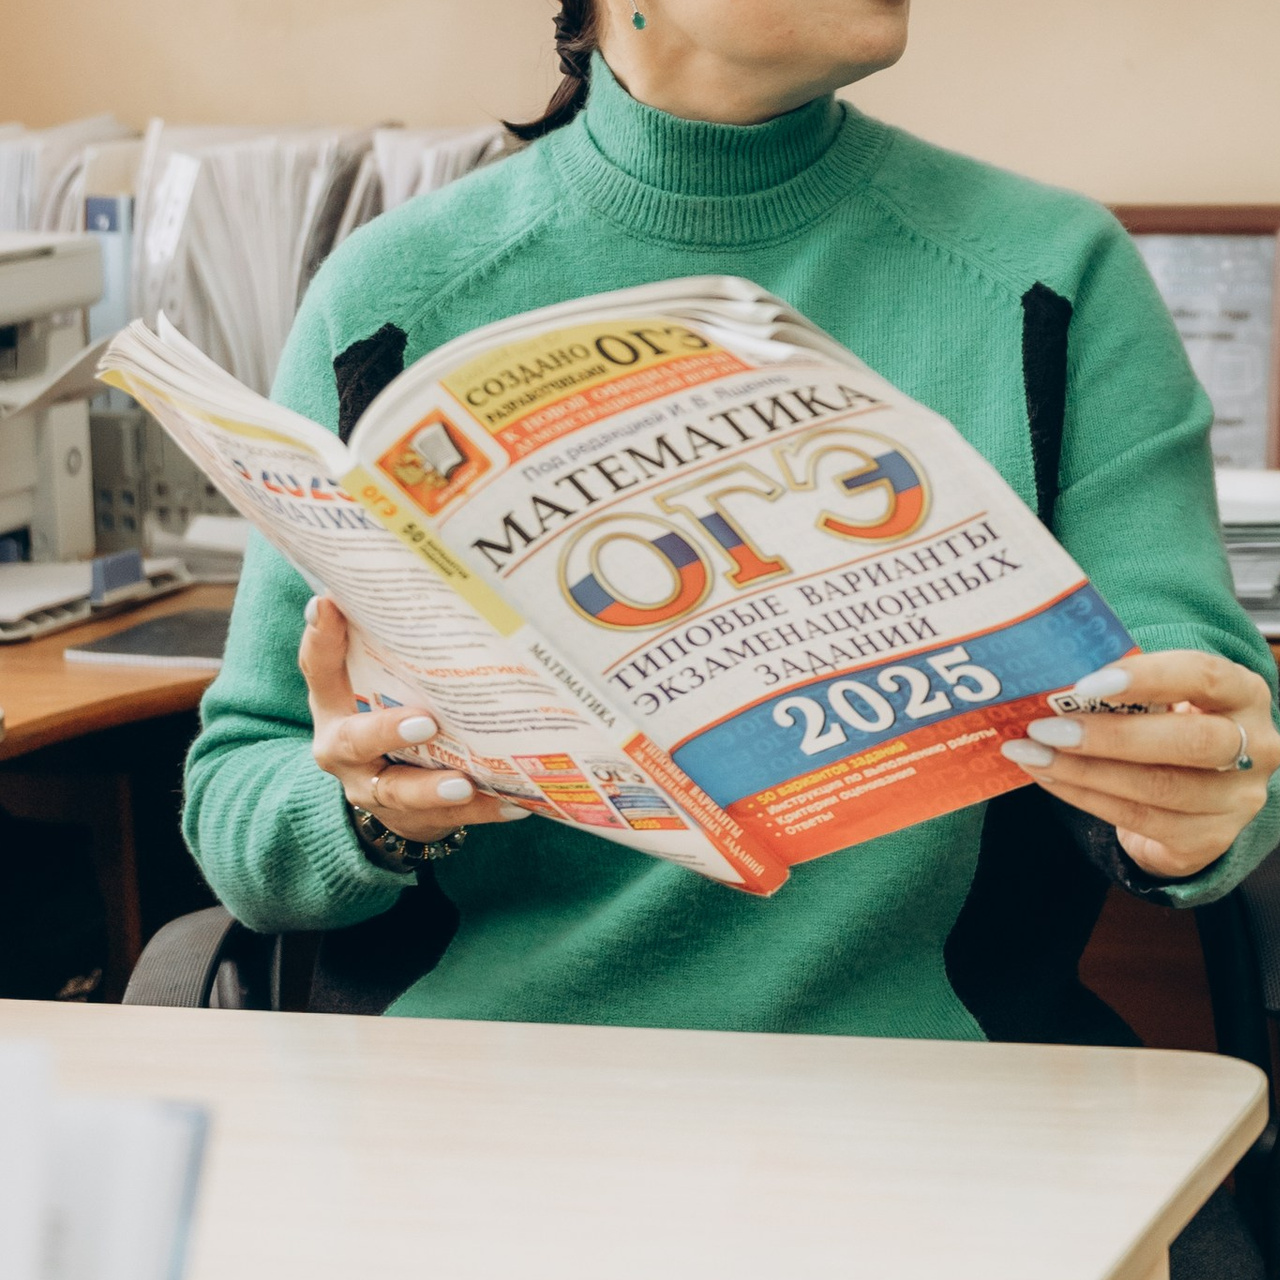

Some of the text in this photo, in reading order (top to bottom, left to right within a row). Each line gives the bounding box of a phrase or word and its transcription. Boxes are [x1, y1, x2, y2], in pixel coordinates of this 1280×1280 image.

[466, 326, 710, 408] СОЗДАНО ОГЭ
[471, 380, 881, 573] МАТЕМАТИКА
[557, 424, 933, 633] ОГЭ
[606, 591, 790, 695] ТИПОВЫЕ
[798, 520, 1001, 610] ВАРИАНТЫ
[631, 549, 1024, 717] ЭКЗАМЕНАЦИОННЫХ
[754, 613, 941, 690] ЗАДАНИЙ
[530, 642, 616, 729] МАТЕМАТИКА
[772, 646, 1002, 757] 2025
[689, 782, 744, 839] ВАРИАНТЫ
[722, 836, 765, 877] ЗАДАНИЙ
